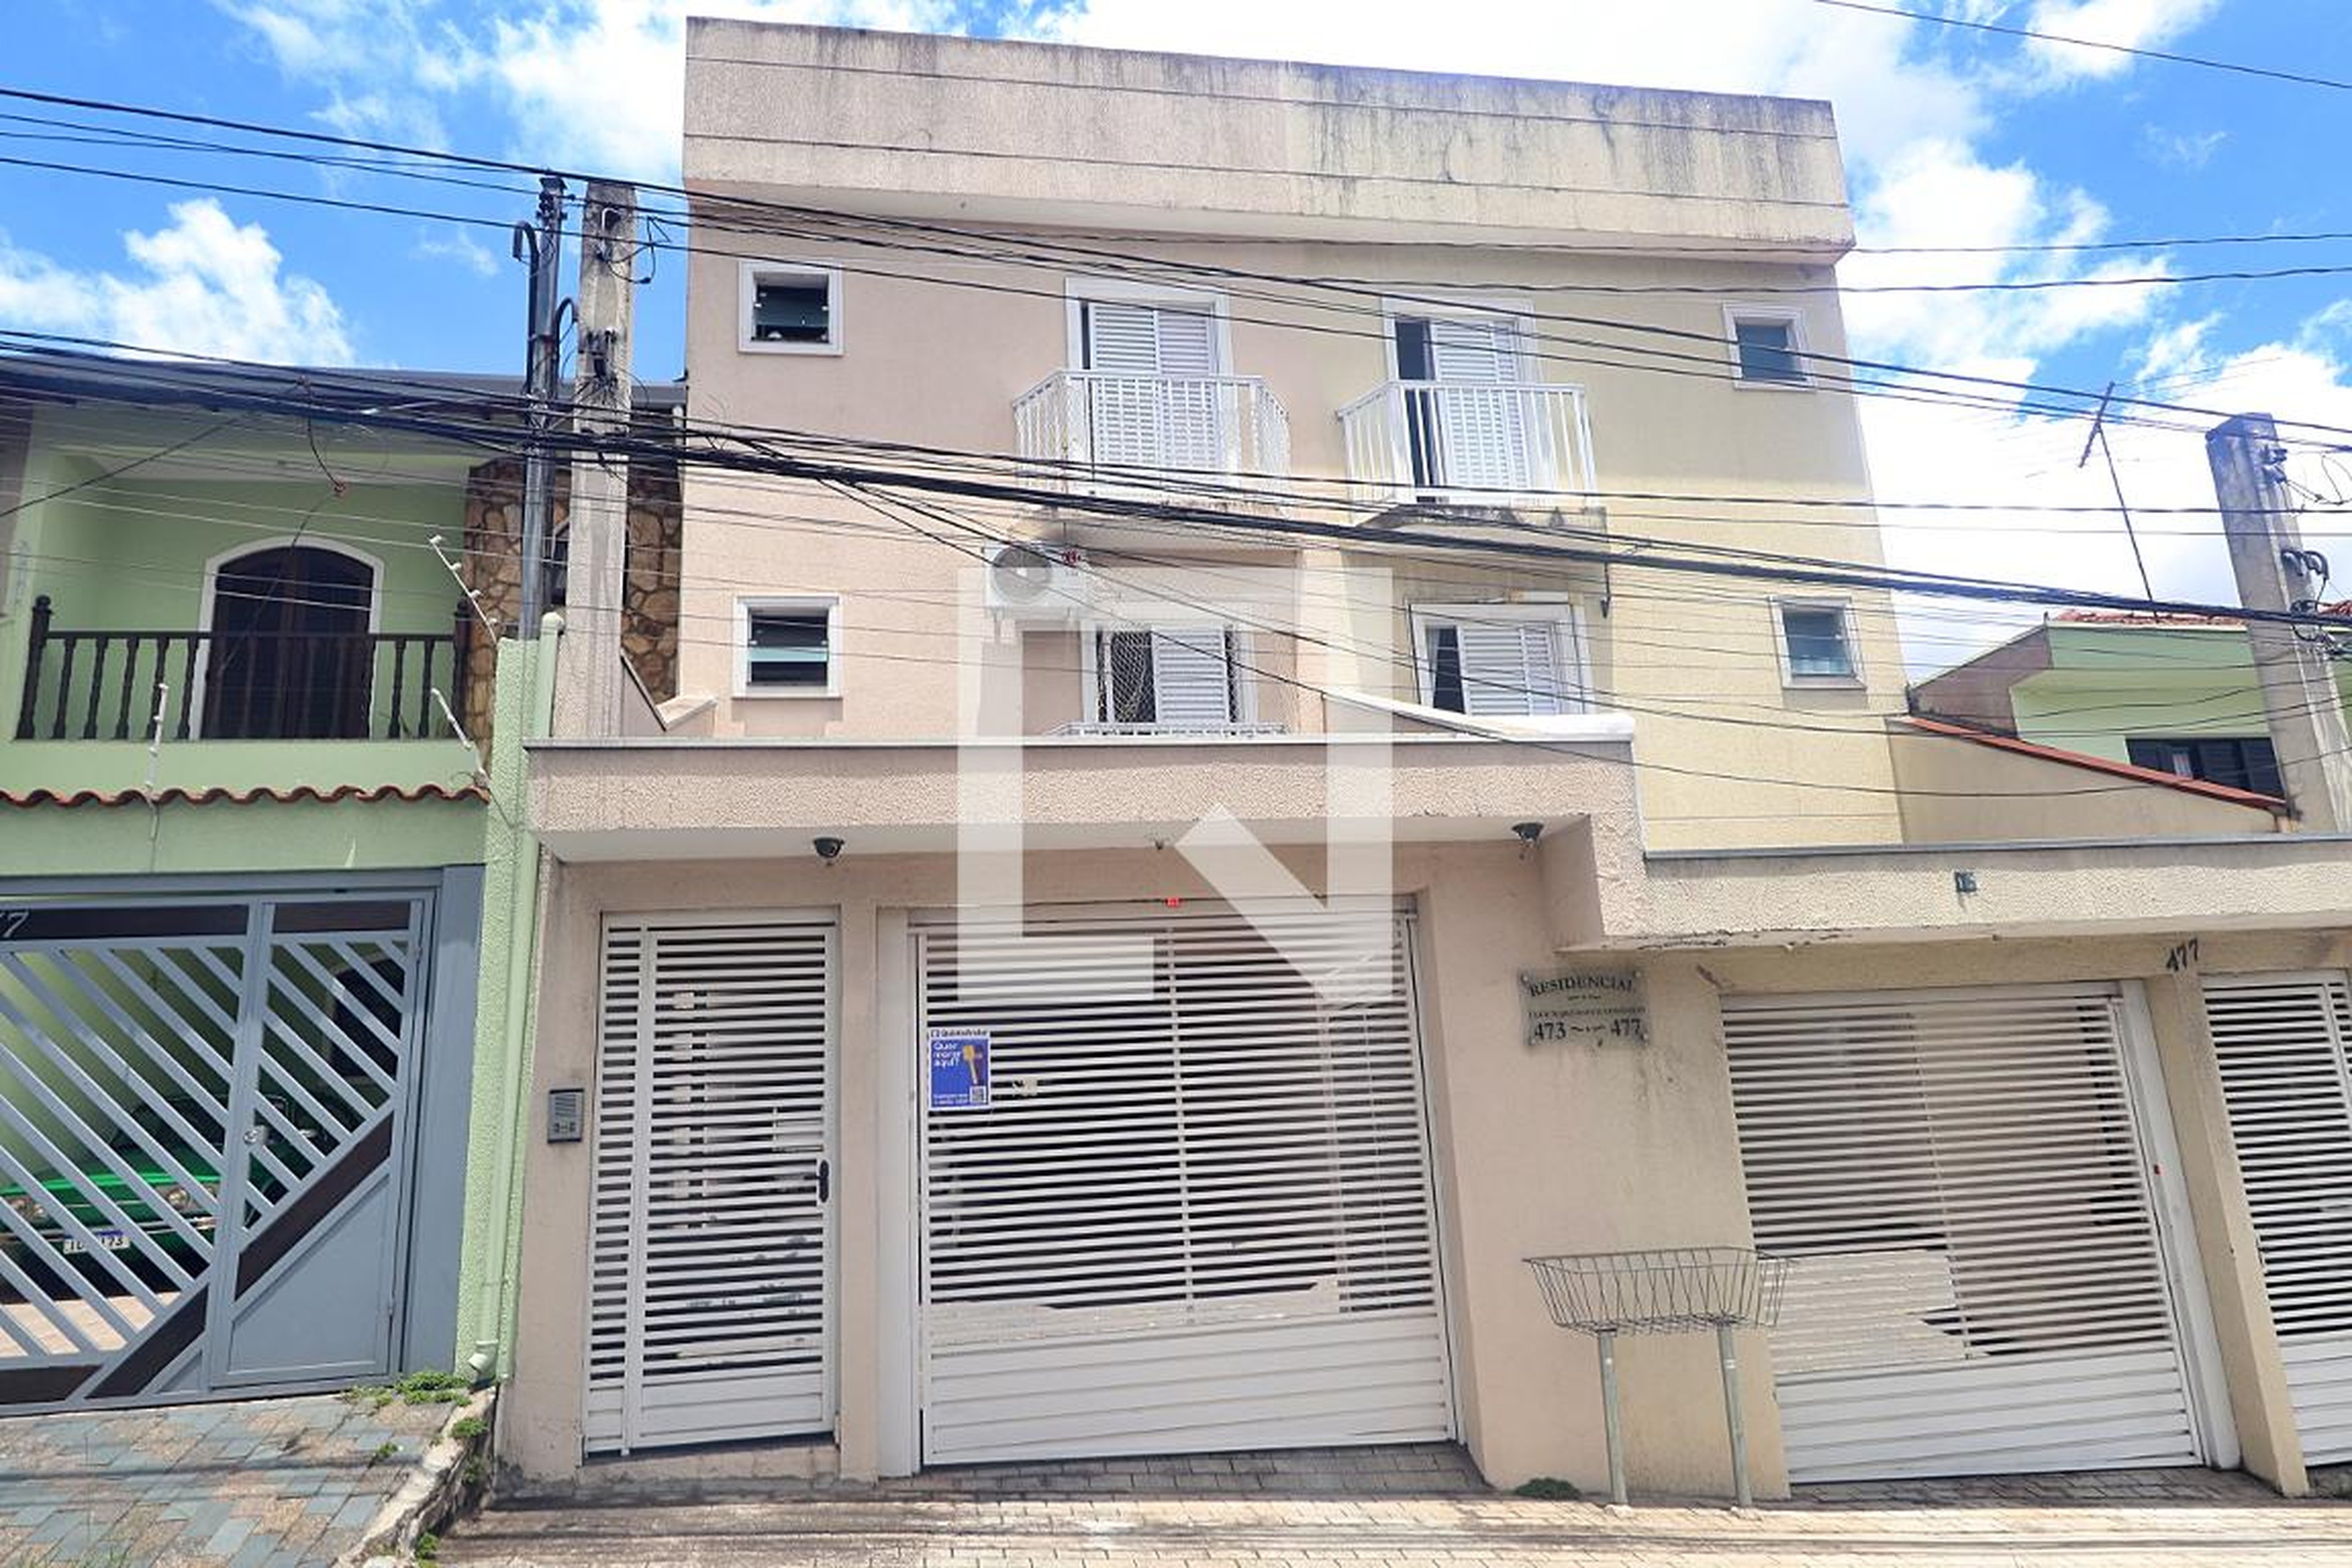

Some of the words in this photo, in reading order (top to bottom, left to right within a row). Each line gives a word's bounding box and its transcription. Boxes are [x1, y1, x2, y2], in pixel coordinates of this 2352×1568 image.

[2166, 937, 2198, 971] 477
[1529, 976, 1634, 997] RESIDENCIAL
[1533, 1022, 1567, 1040] 473
[1610, 1017, 1642, 1036] 477
